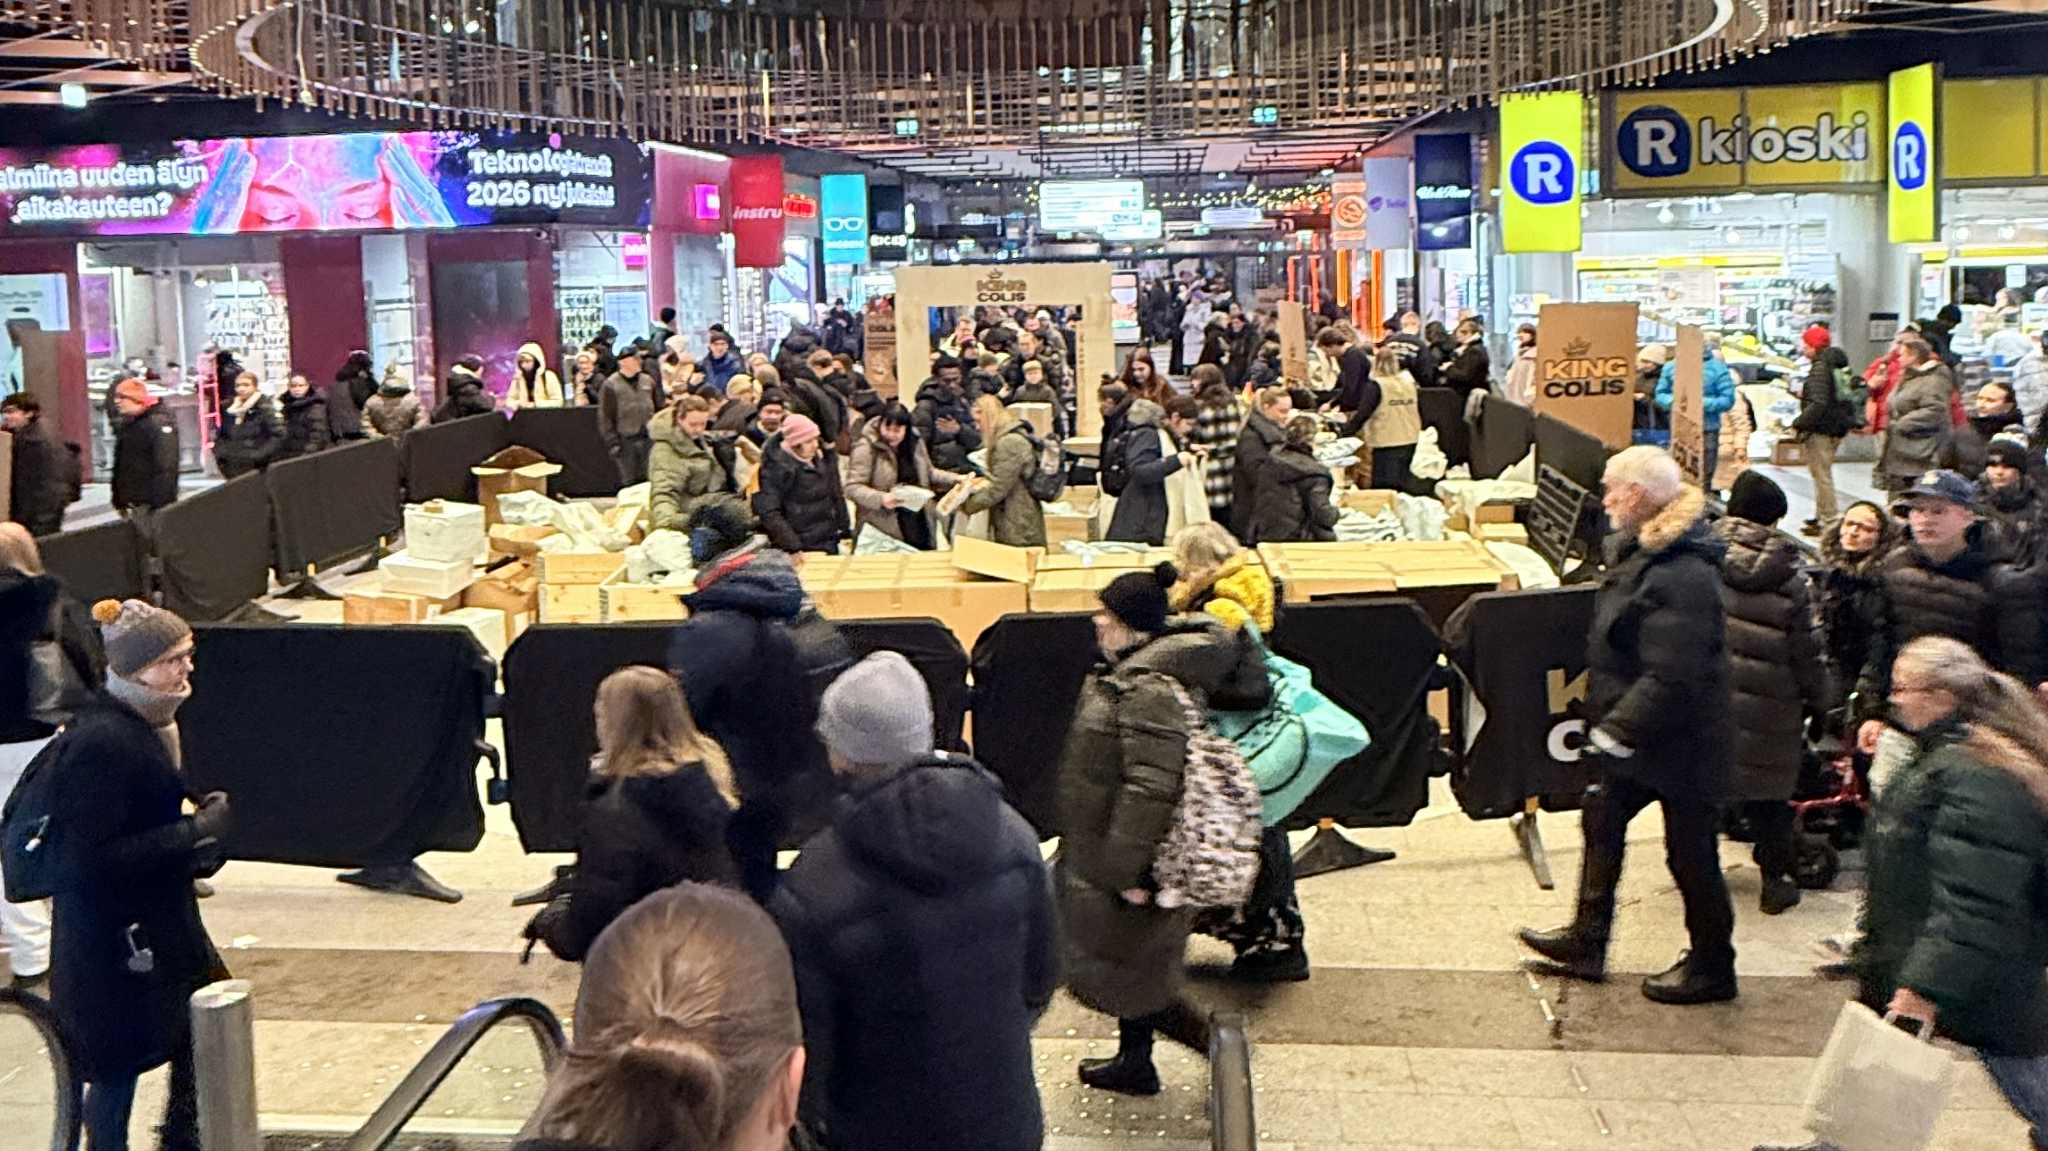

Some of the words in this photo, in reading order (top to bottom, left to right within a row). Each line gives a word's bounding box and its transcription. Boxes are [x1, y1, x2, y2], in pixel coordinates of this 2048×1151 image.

[1633, 118, 1678, 167] R
[1700, 110, 1868, 165] kioski
[1897, 134, 1920, 181] R
[80, 161, 155, 187] uuden
[157, 158, 209, 189] älyn
[1523, 153, 1563, 195] R
[17, 191, 173, 221] aikakauteen?
[466, 179, 531, 206] 2026
[733, 206, 783, 219] instru
[977, 292, 1026, 302] COLIS
[1544, 357, 1629, 380] KING
[1544, 379, 1625, 398] COLIS
